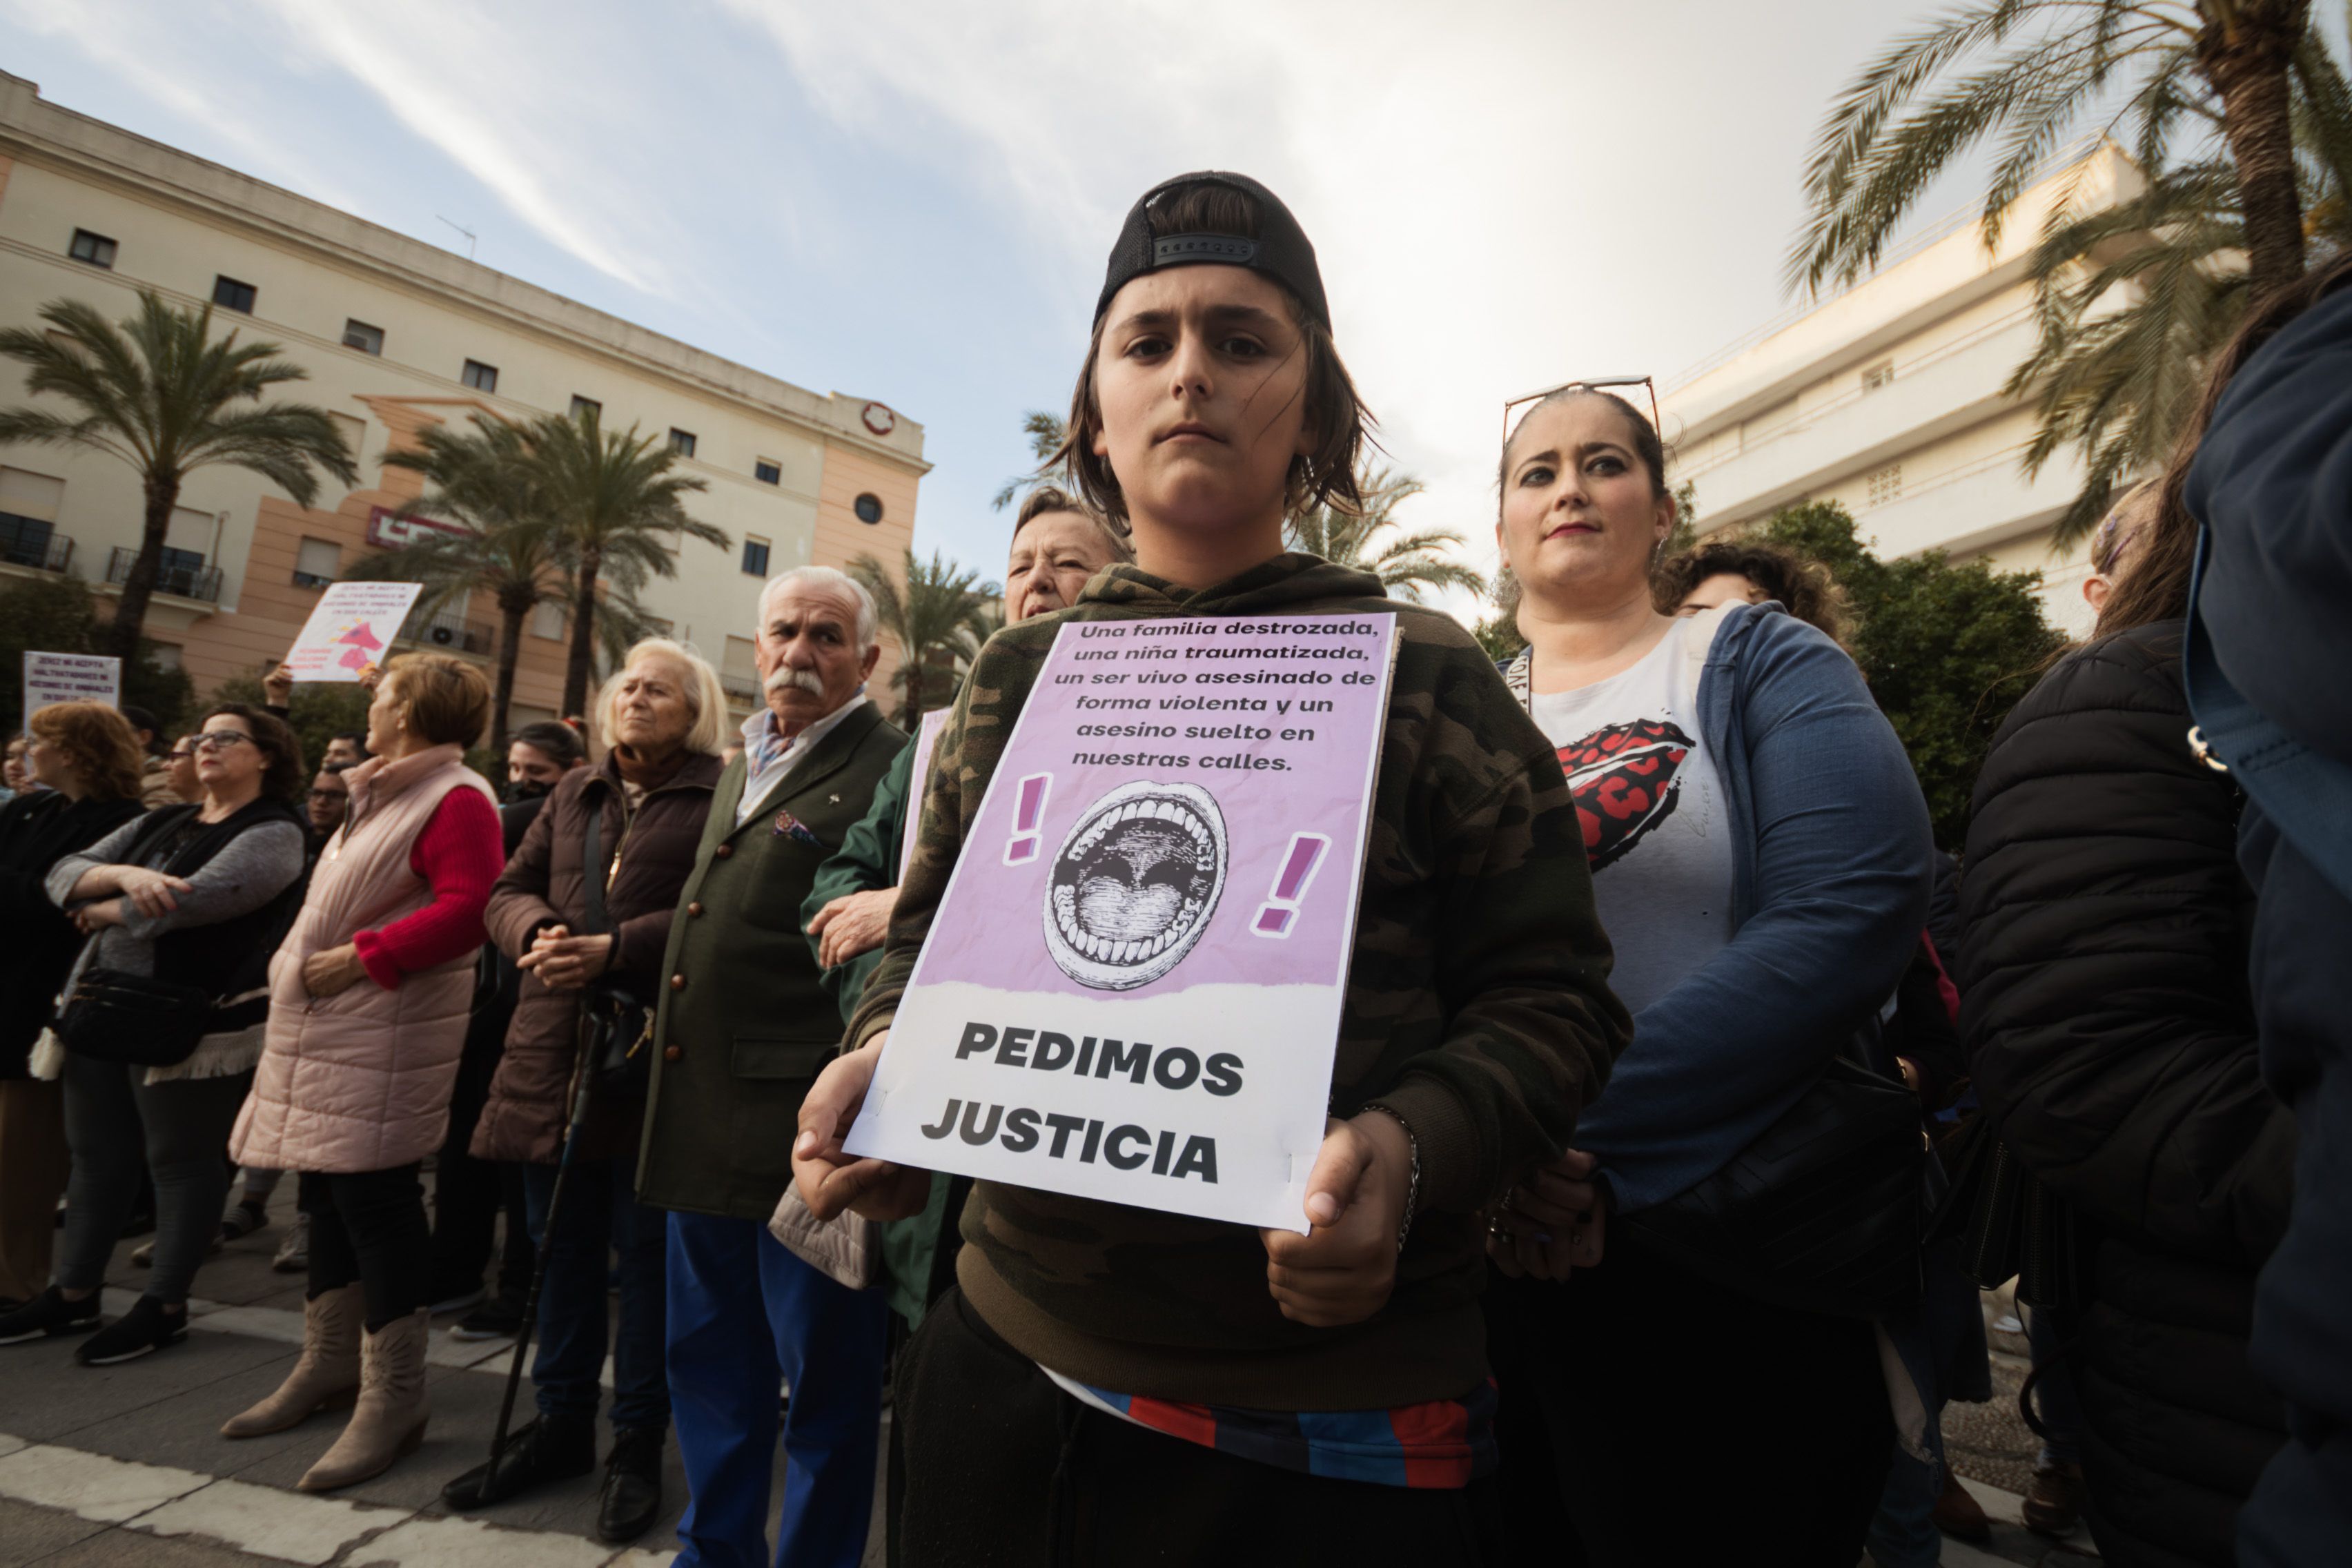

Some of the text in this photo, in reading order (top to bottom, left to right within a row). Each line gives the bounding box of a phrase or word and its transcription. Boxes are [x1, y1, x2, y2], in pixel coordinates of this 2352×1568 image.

[1080, 620, 1379, 638] Una familia destrozada,
[1073, 645, 1370, 663] una niña traumatizada,
[1054, 669, 1376, 686] un ser vivo asesinado de
[1076, 695, 1334, 716] forma violenta y un
[1077, 721, 1315, 742] asesino suelto en
[1072, 752, 1293, 772] nuestras calles.
[954, 1021, 1245, 1097] PEDIMOS
[921, 1099, 1219, 1185] JUSTICIA
